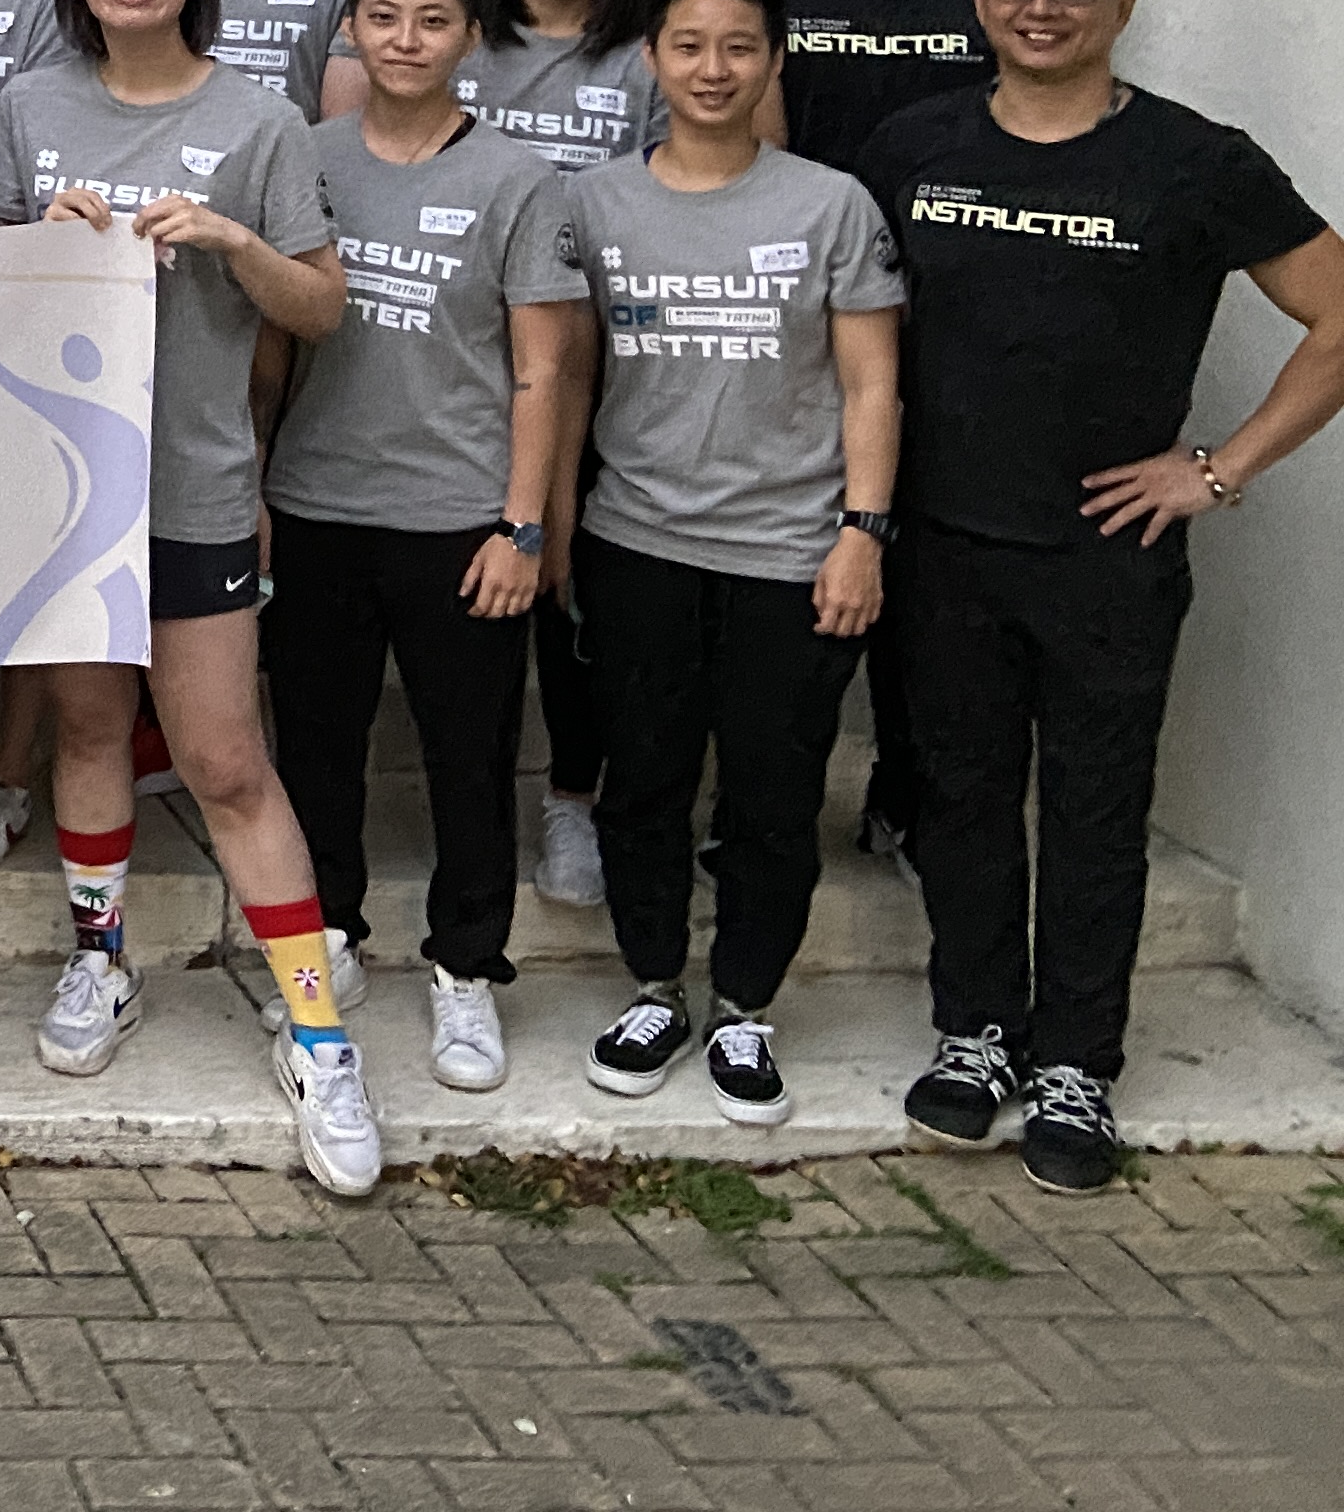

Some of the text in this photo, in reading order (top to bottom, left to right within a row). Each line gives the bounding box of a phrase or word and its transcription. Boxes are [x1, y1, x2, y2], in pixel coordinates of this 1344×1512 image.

[222, 19, 308, 43] SUIT
[788, 33, 968, 56] INSTRUCTOR
[912, 199, 1115, 240] INSTRUCTOR
[337, 236, 462, 280] RSUIT
[608, 274, 800, 300] PURSUIT
[612, 305, 657, 326] OF
[613, 333, 781, 360] BETTER
